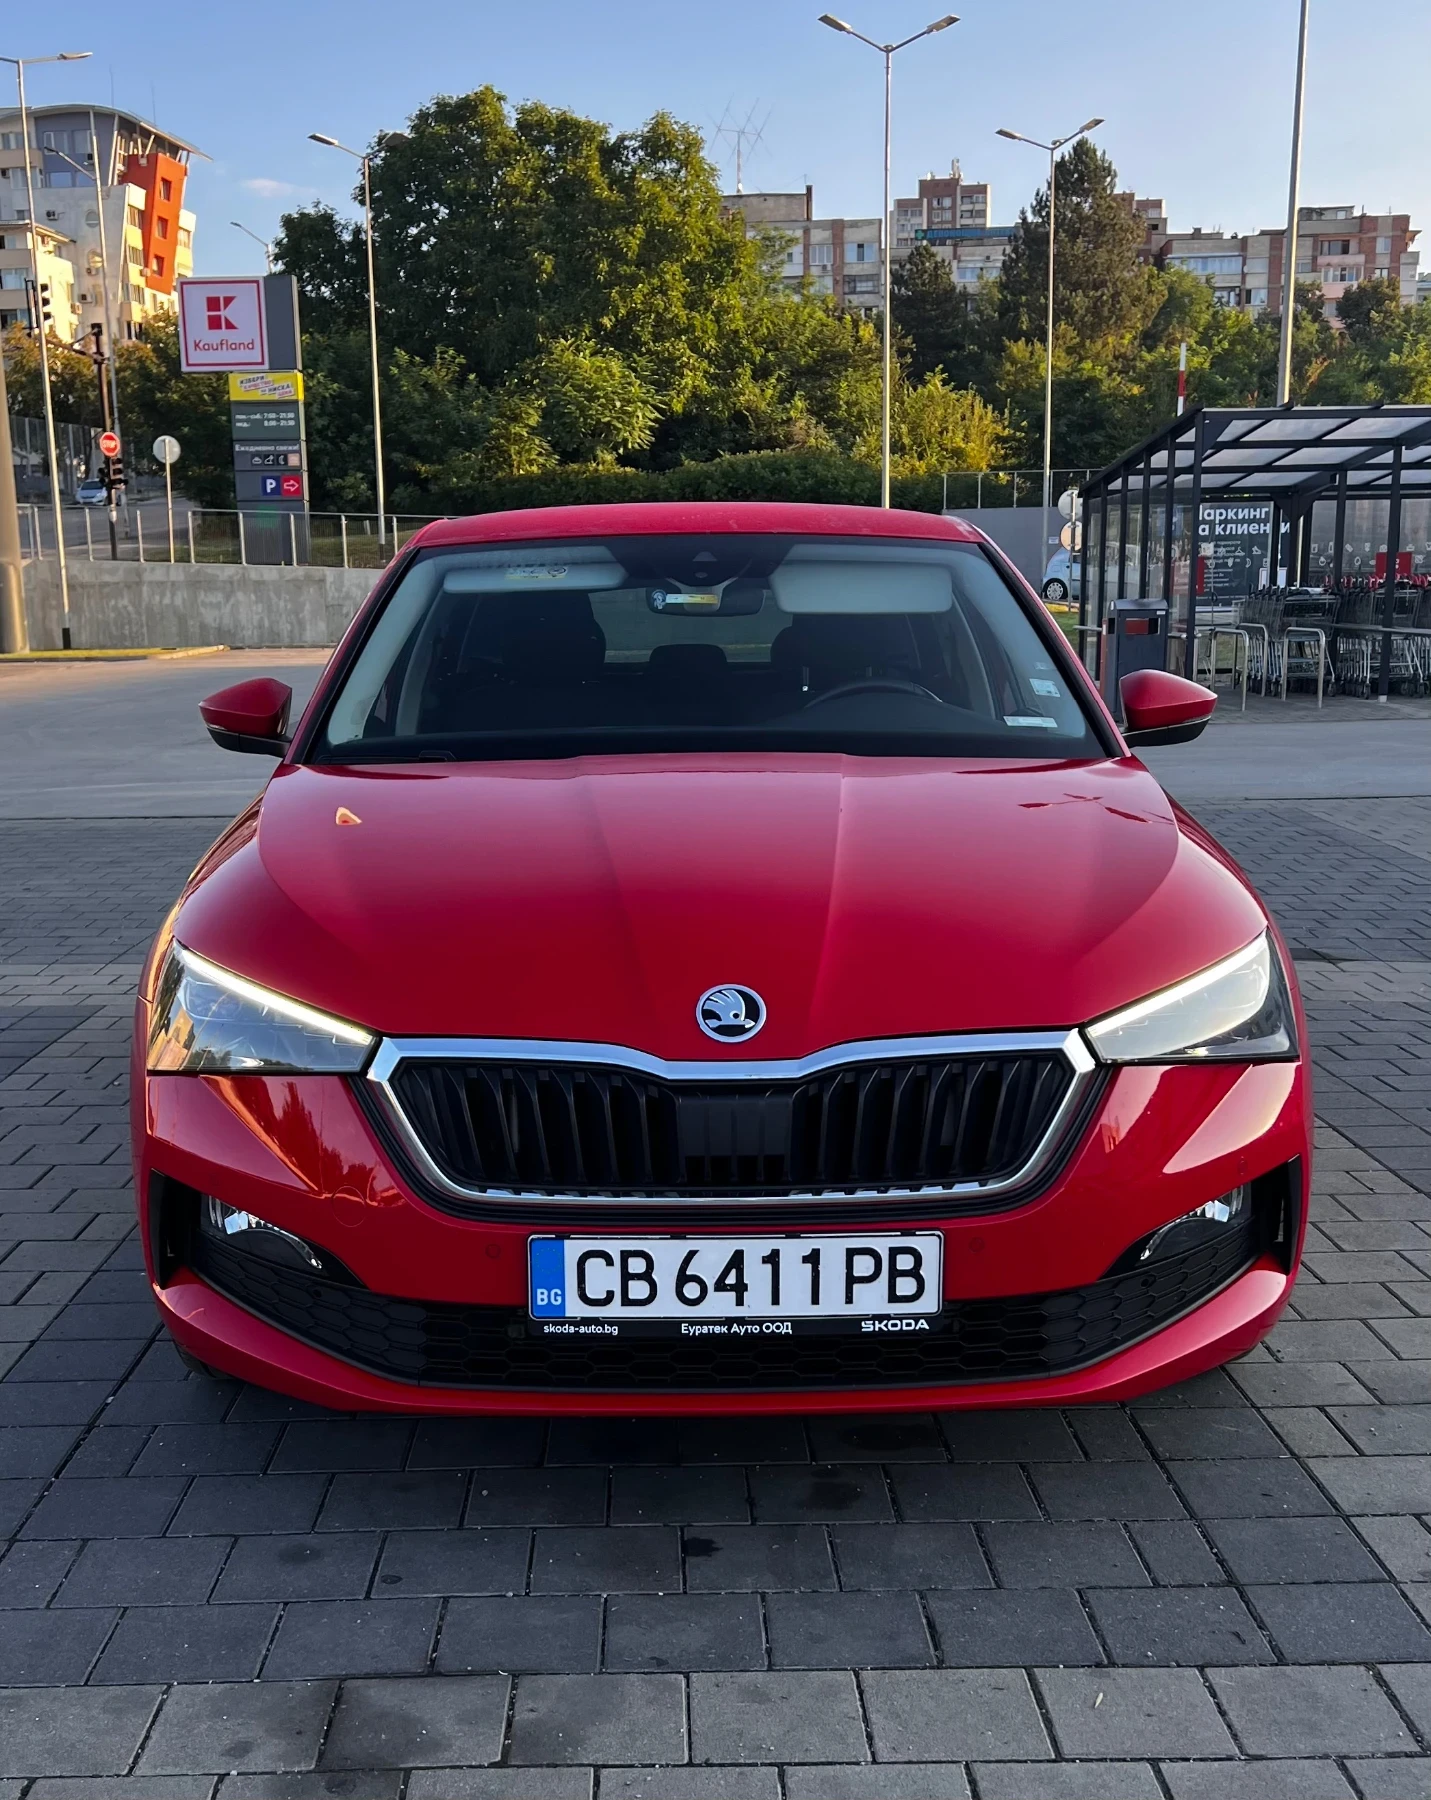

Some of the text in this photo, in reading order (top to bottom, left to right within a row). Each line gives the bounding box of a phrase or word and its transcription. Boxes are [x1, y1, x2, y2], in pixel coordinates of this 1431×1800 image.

[194, 338, 255, 351] Kaufland
[266, 478, 276, 493] P
[1198, 522, 1290, 535] а клиени
[577, 1246, 926, 1307] CB 6411 PB
[536, 1288, 562, 1306] BG
[543, 1323, 619, 1336] skoda-auto.bg
[681, 1321, 793, 1336] Еуратек Ауто ООД
